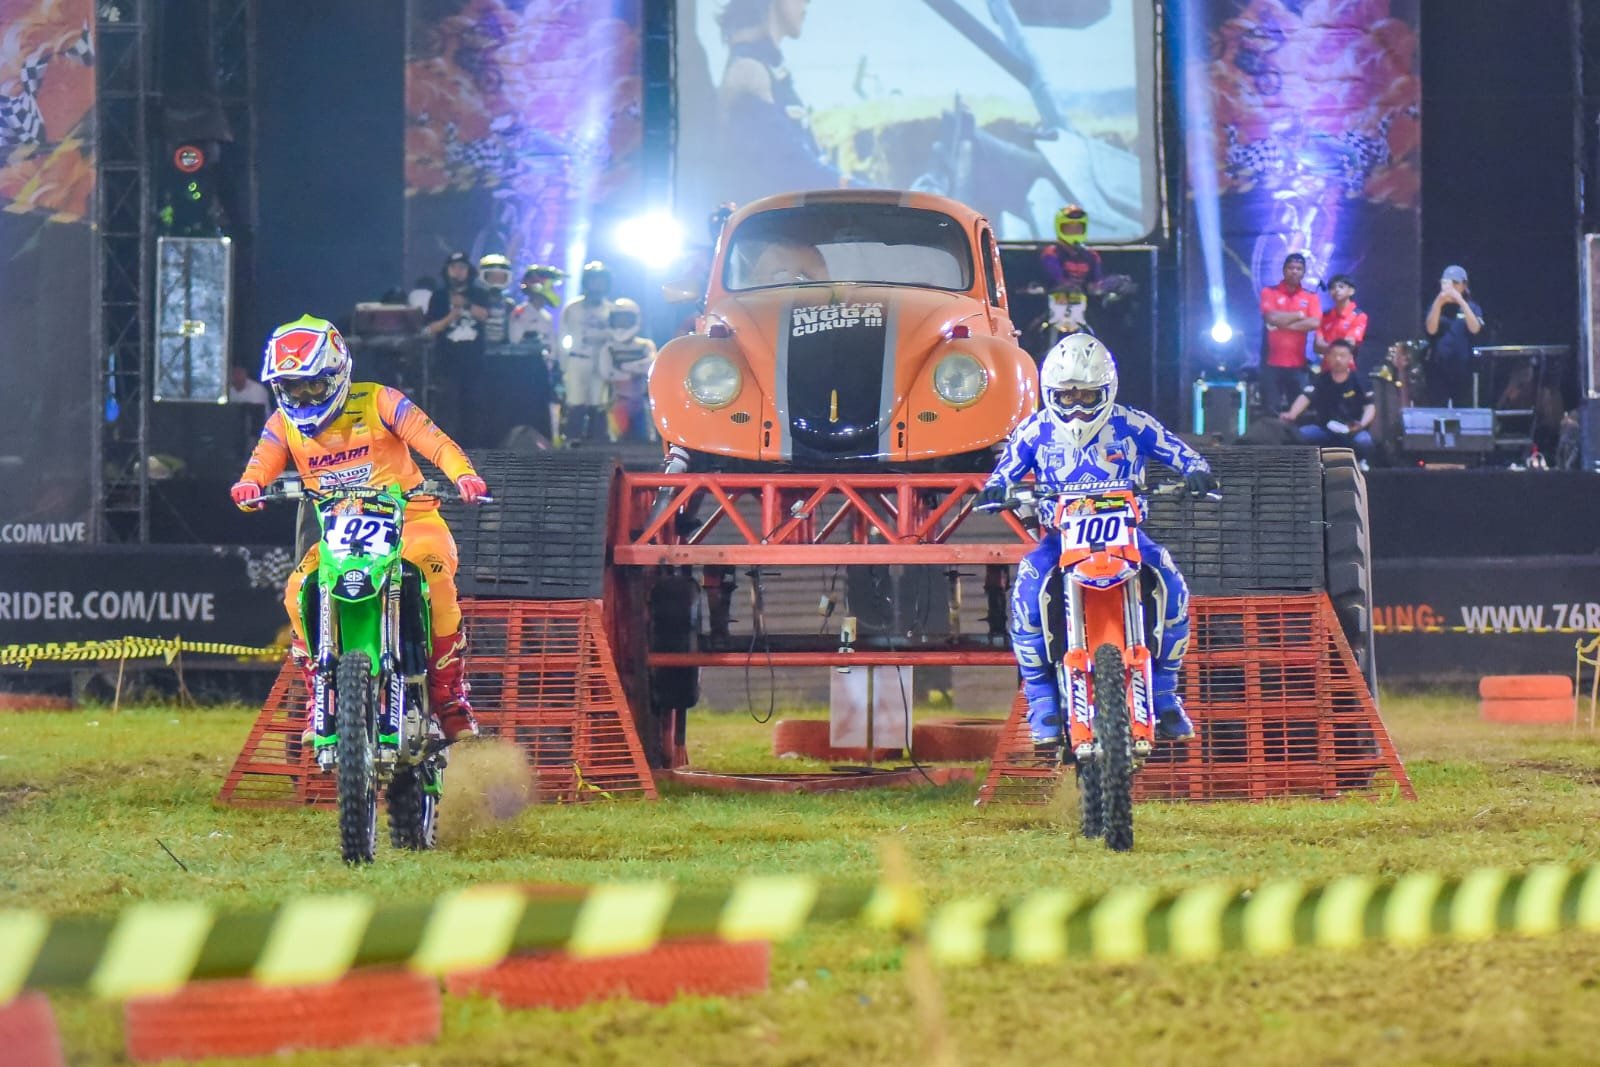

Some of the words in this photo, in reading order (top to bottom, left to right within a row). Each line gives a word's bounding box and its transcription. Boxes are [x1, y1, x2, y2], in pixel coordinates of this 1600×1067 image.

[792, 318, 860, 336] CUKUP
[865, 318, 882, 327] !!!
[793, 307, 882, 326] NGGA
[1063, 480, 1128, 492] RENTHAL
[340, 518, 381, 547] 92
[1076, 516, 1121, 544] 100
[0, 591, 215, 623] RIDER.COM/LIVE
[1460, 602, 1600, 633] WWW.76R
[390, 673, 399, 728] DUNLOP
